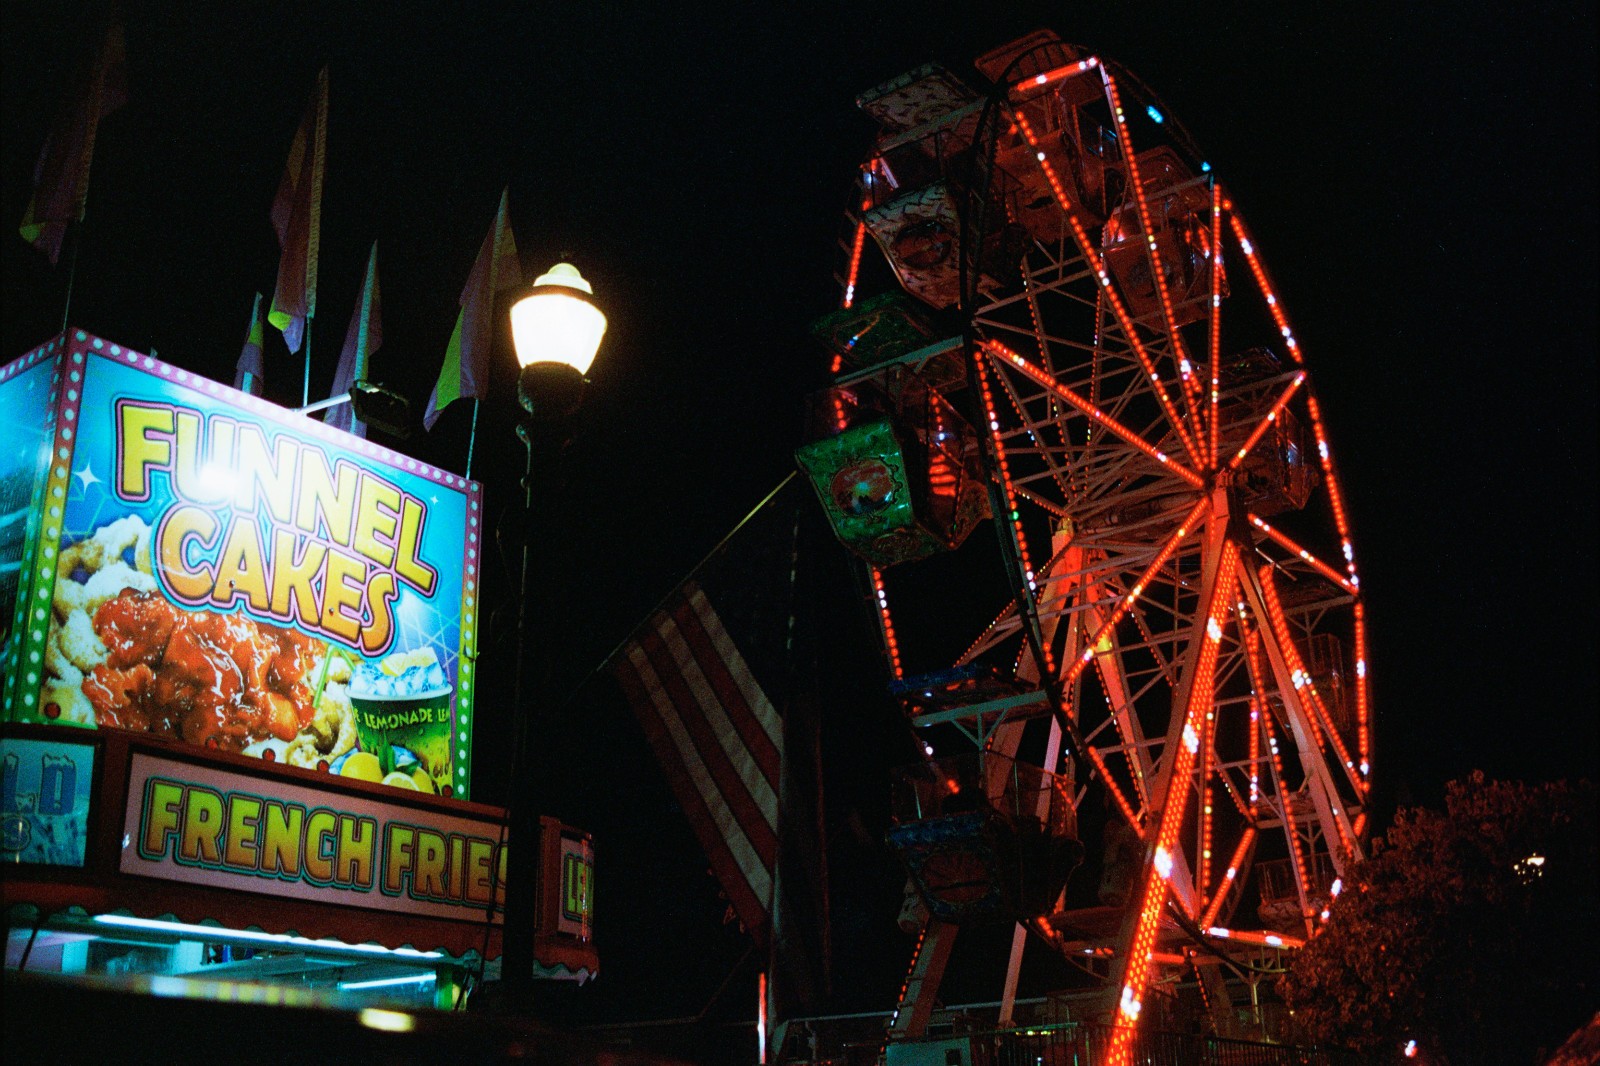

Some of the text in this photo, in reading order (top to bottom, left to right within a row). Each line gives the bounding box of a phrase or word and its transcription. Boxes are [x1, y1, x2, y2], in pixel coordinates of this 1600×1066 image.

[115, 397, 438, 599] FUNNEL
[156, 499, 400, 657] CAKES
[363, 707, 433, 729] LEMONADE
[139, 777, 380, 890] FRENCH
